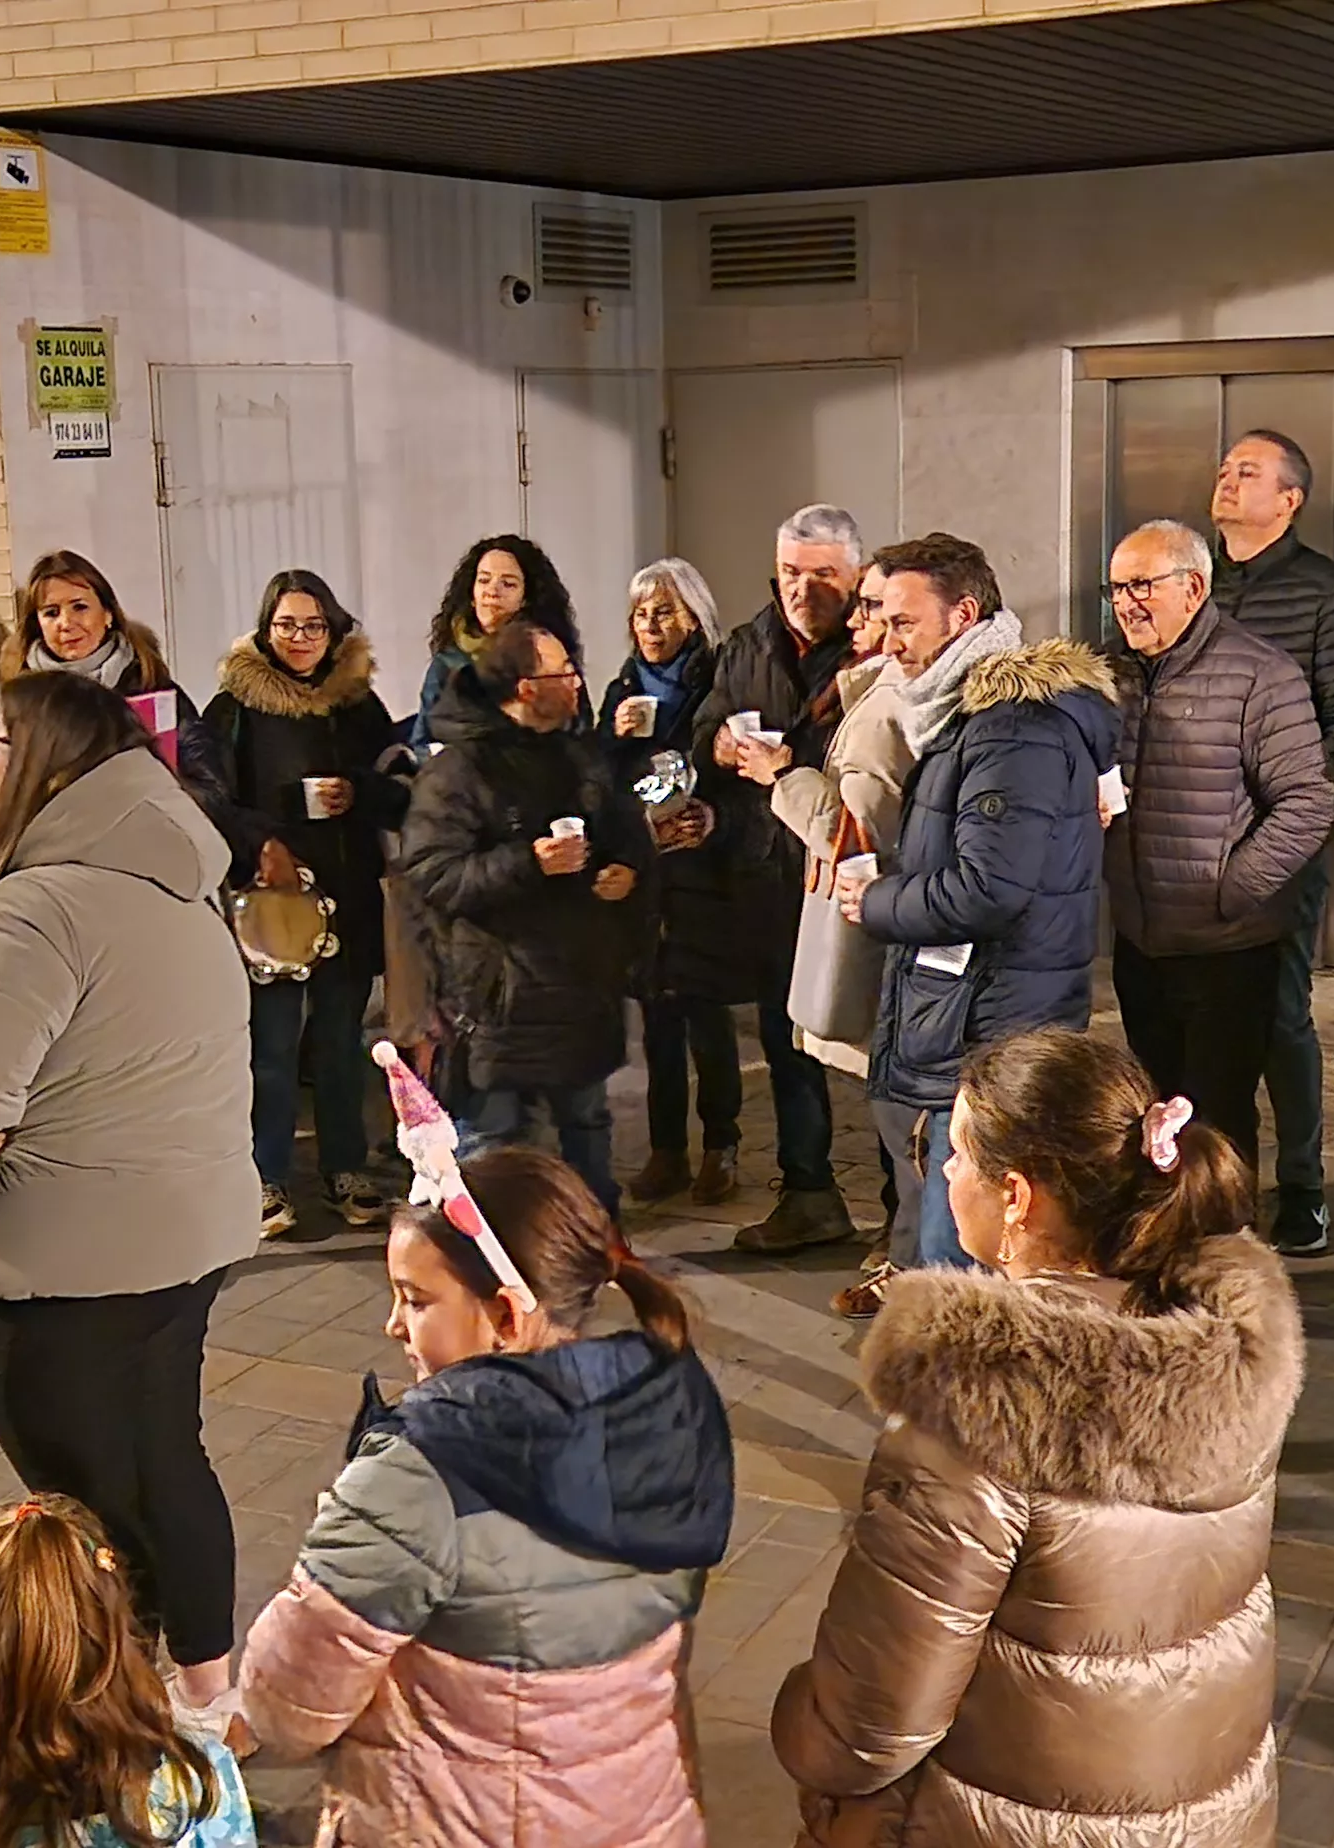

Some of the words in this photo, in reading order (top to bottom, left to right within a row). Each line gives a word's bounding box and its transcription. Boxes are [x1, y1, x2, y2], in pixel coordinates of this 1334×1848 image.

[36, 339, 51, 356] SE
[55, 339, 106, 357] ALQUILA
[40, 365, 106, 388] GARAJE
